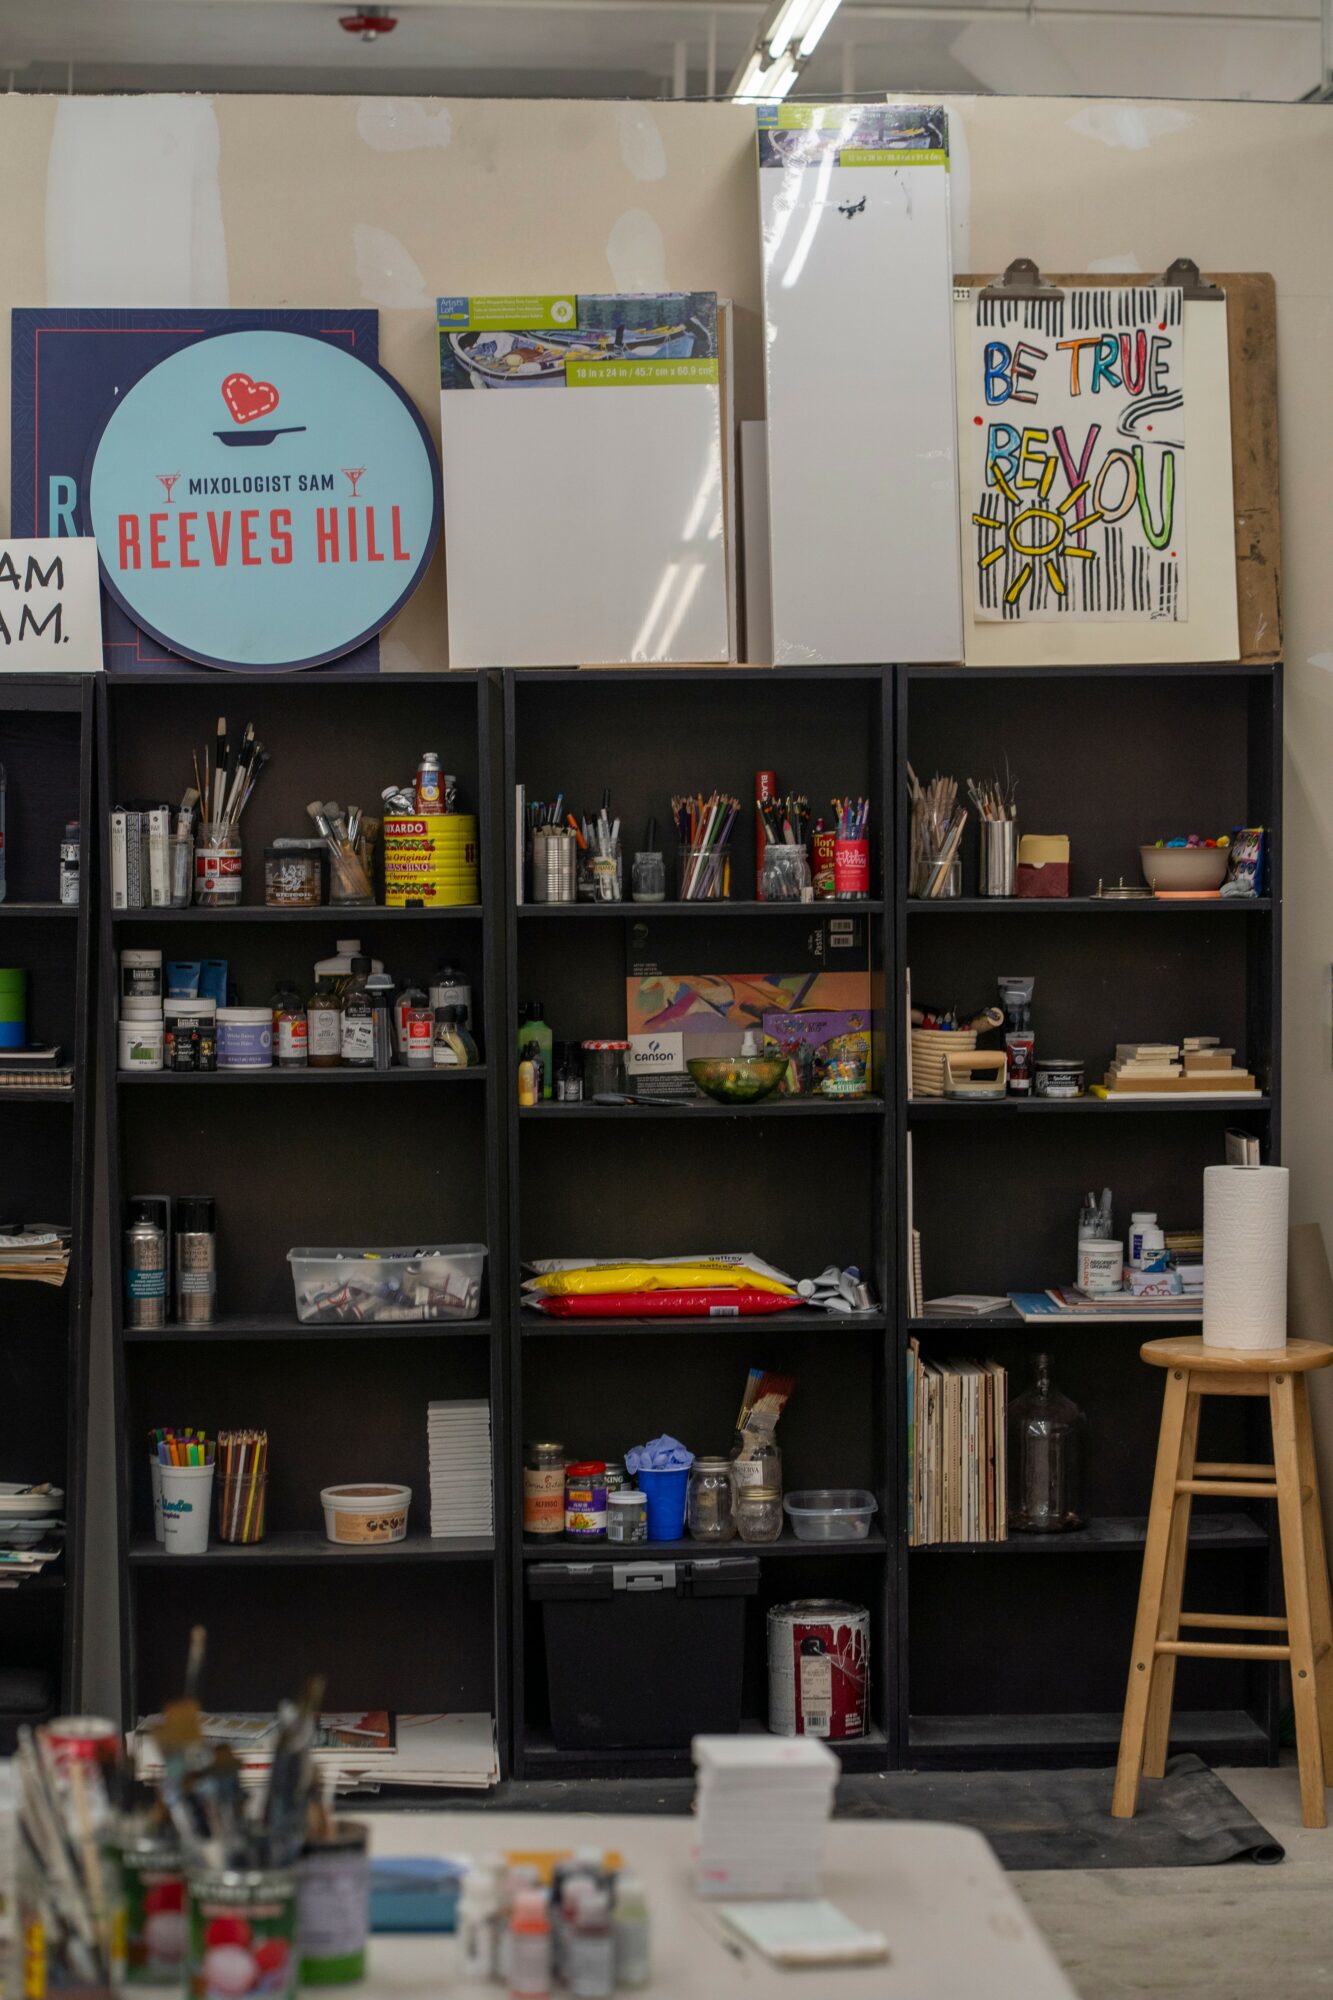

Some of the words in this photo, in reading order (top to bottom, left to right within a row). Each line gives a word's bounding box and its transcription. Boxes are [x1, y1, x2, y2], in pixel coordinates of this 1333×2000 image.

[440, 306, 454, 314] Loft
[984, 341, 1048, 406] BE
[1056, 329, 1172, 396] TRUE
[577, 369, 586, 378] 18
[589, 368, 596, 377] in
[606, 368, 616, 377] 24
[620, 368, 626, 377] in
[634, 368, 652, 376] 45.7
[189, 475, 292, 495] MIXOLOGIST
[299, 474, 334, 491] SAM
[118, 508, 293, 570] REEVES
[316, 505, 410, 563] HILL
[385, 823, 423, 833] UXARDO
[393, 853, 432, 862] Original
[634, 1052, 674, 1062] CANSON
